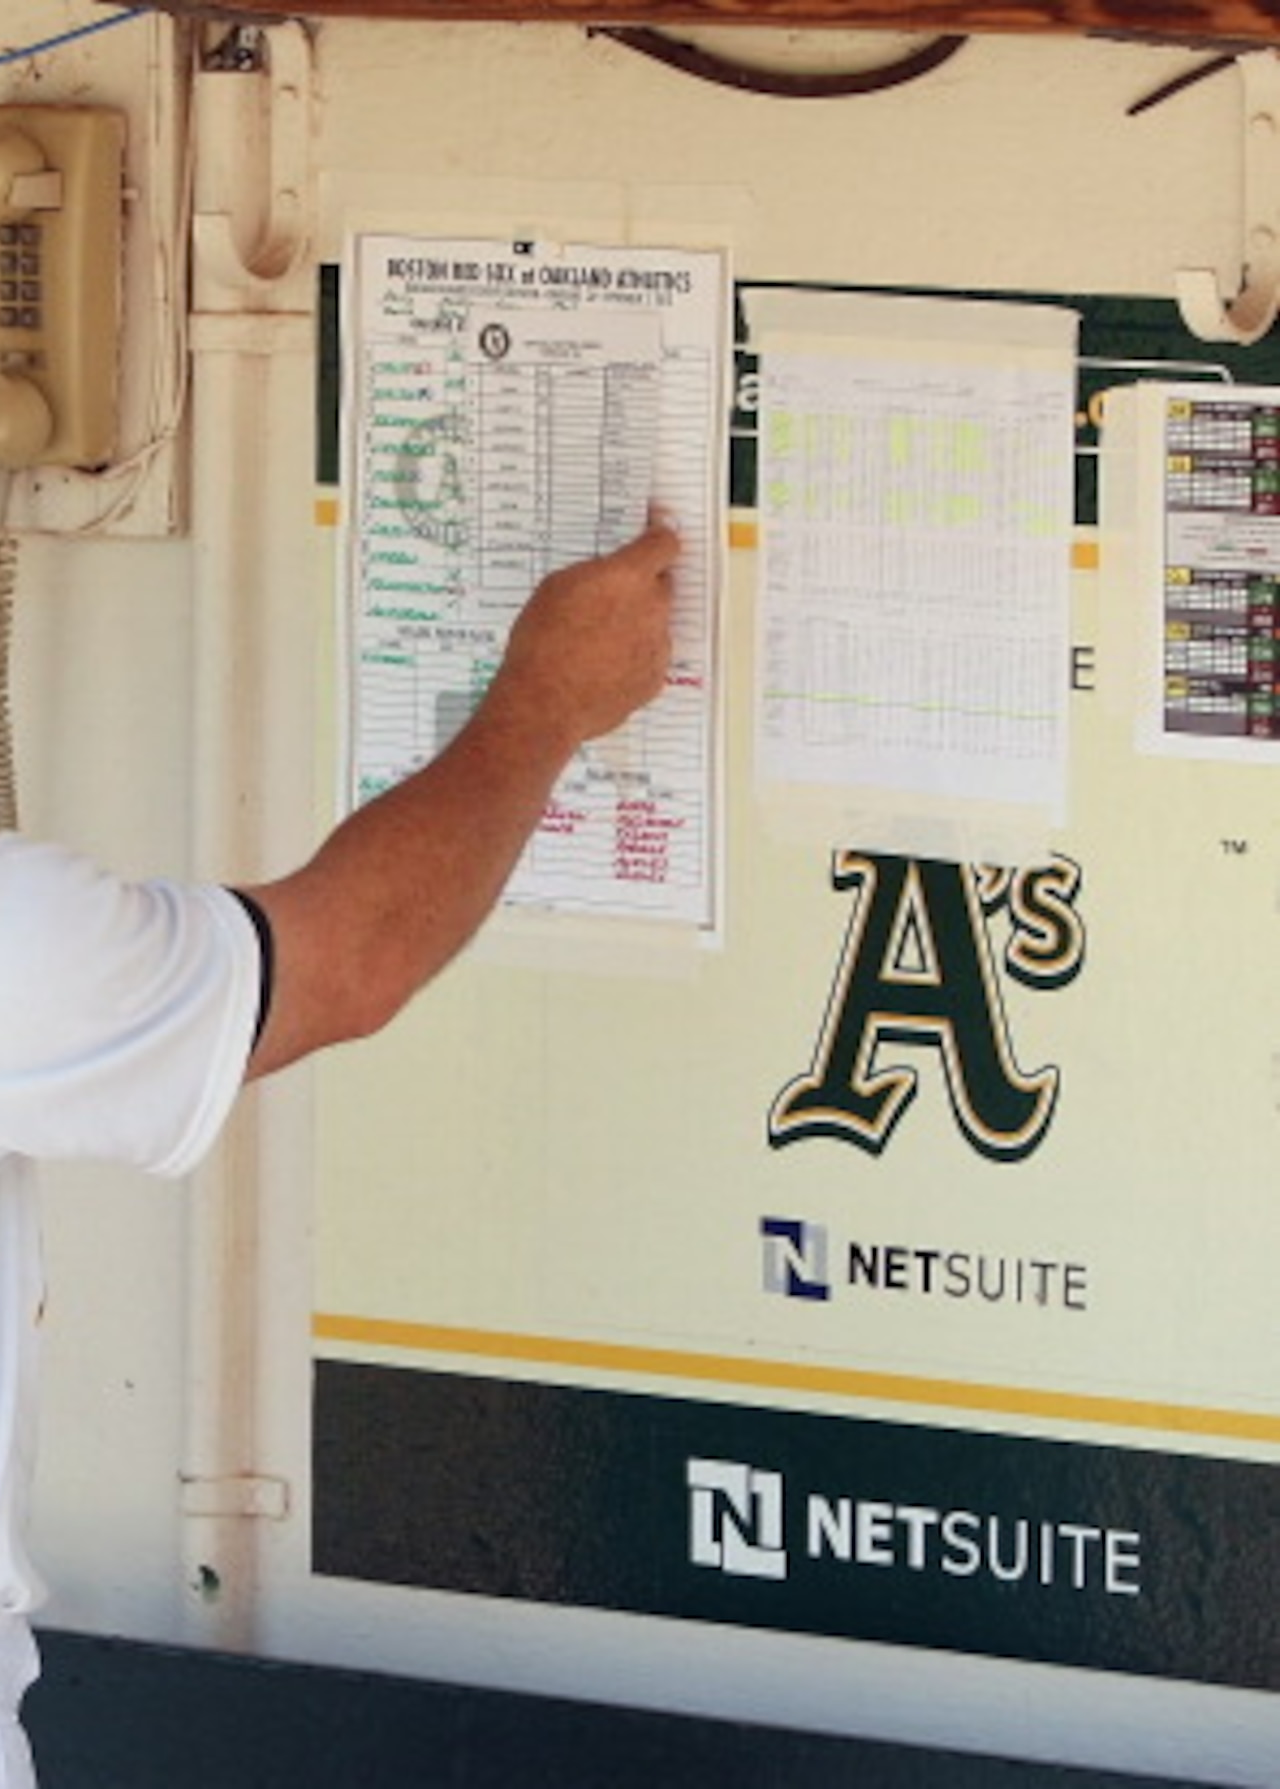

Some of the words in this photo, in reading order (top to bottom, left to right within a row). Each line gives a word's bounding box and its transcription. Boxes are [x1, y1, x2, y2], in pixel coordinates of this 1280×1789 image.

[487, 261, 515, 284] SOX
[539, 264, 612, 289] OAKLAND
[616, 269, 692, 294] ATHLETICS
[1222, 841, 1247, 855] TM
[847, 1243, 1088, 1311] NETSUITE
[806, 1494, 1142, 1596] NETSUITE
